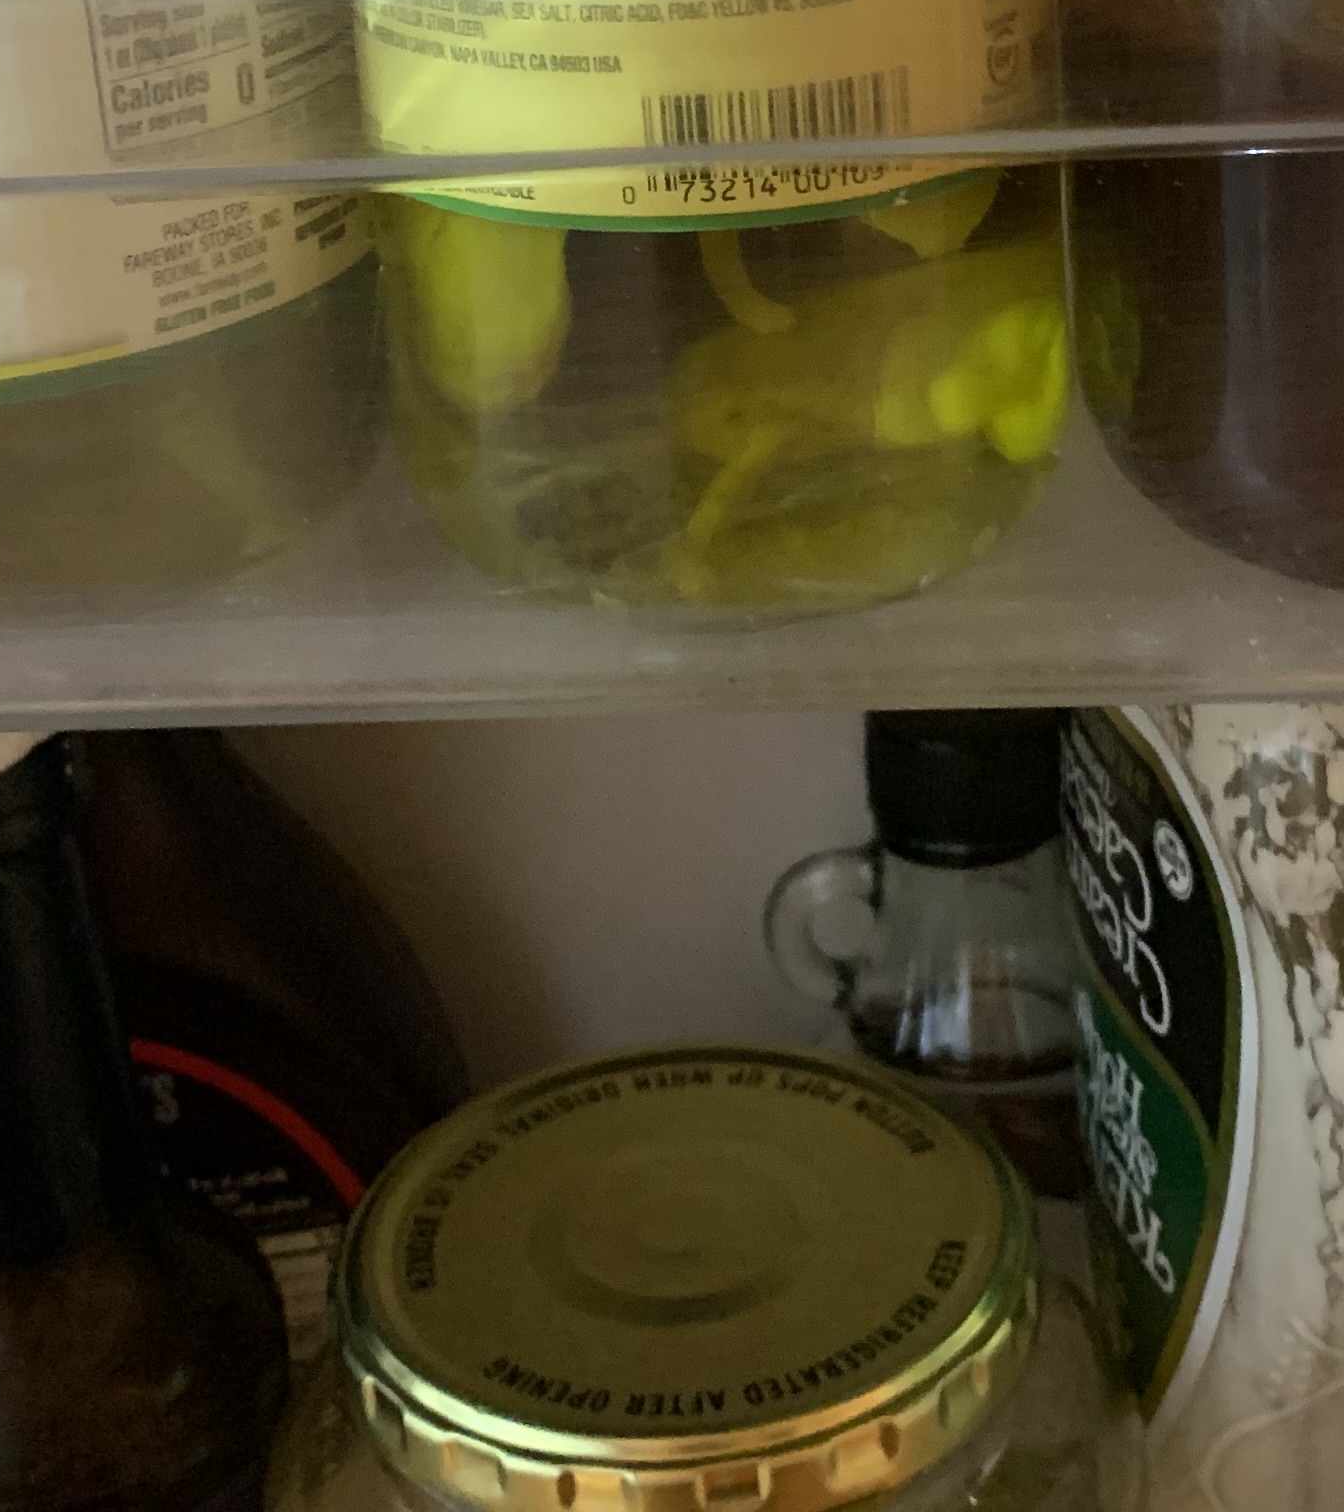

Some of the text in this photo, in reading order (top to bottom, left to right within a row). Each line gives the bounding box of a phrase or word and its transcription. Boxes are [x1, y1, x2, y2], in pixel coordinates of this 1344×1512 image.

[512, 2, 535, 20] SEA
[580, 4, 624, 23] CITRIC
[450, 45, 479, 65] NAPA
[480, 50, 527, 70] VALLEY,
[529, 53, 548, 71] CA
[593, 55, 622, 73] USA
[111, 62, 255, 114] Calories 0
[622, 185, 636, 206] 0
[679, 177, 778, 203] 73214
[161, 209, 219, 240] PACKED
[123, 240, 194, 273] FAREWAY
[482, 1240, 968, 1417] KEEP REFRIGERATED AFTER OPENING
